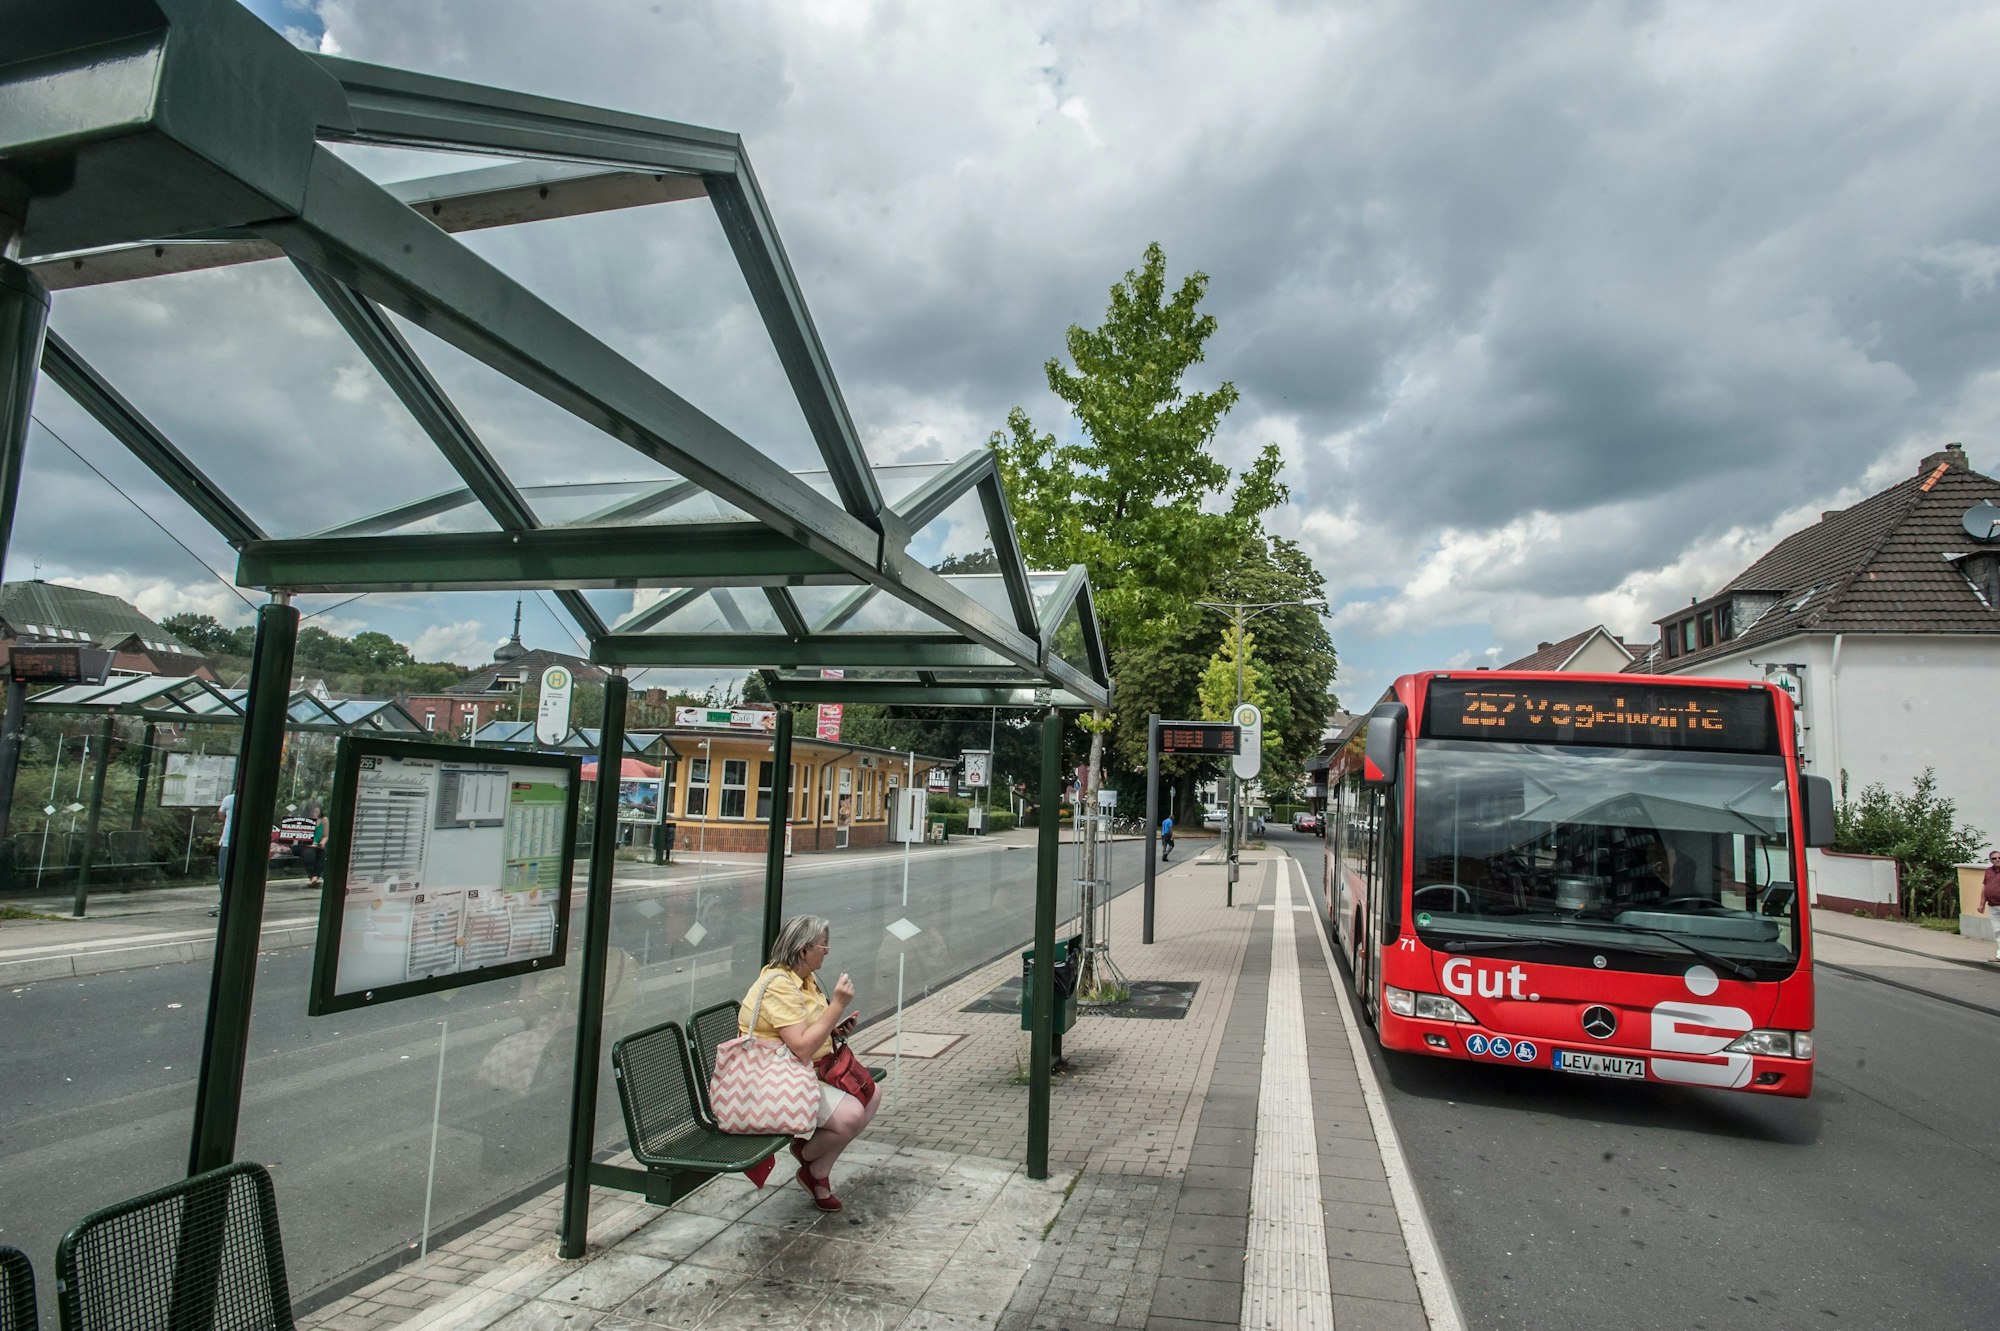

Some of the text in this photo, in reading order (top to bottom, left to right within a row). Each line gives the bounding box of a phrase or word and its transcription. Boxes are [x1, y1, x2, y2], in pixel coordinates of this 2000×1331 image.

[552, 674, 562, 685] H
[732, 713, 751, 722] Café
[1243, 713, 1251, 722] H
[360, 759, 374, 768] 255
[1400, 938, 1415, 952] 71
[1442, 957, 1540, 1001] Gut.
[1562, 1054, 1592, 1069] LEV
[1602, 1058, 1622, 1073] WU
[1625, 1061, 1644, 1076] 71
